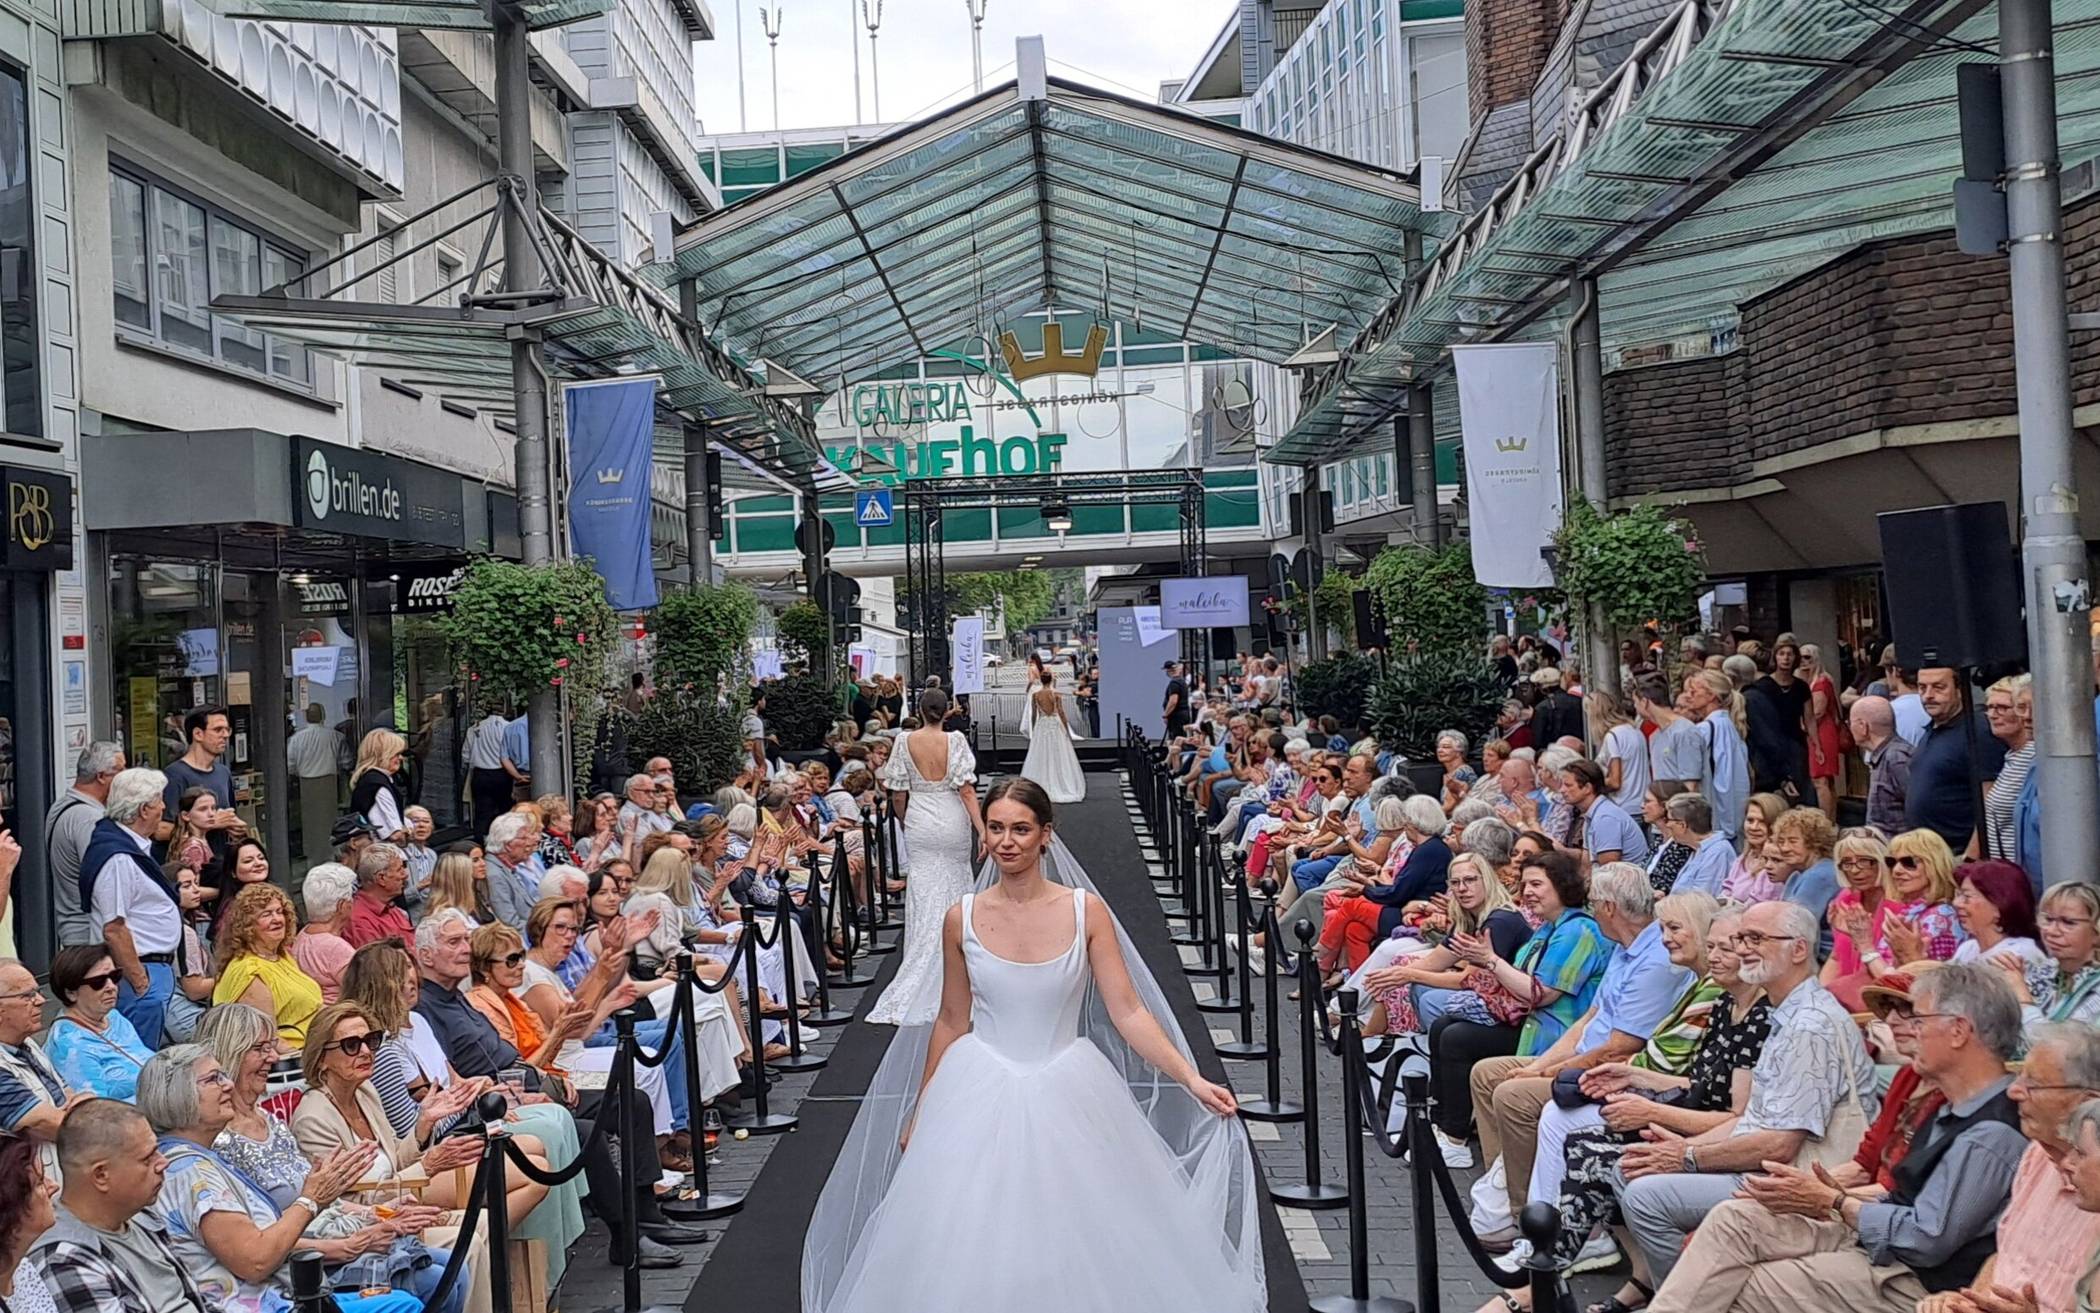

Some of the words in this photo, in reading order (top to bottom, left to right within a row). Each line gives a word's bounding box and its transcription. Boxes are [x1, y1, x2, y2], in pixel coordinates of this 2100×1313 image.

[853, 381, 972, 427] GALERIA
[331, 466, 400, 521] brillen.de
[408, 576, 461, 597] ROSE
